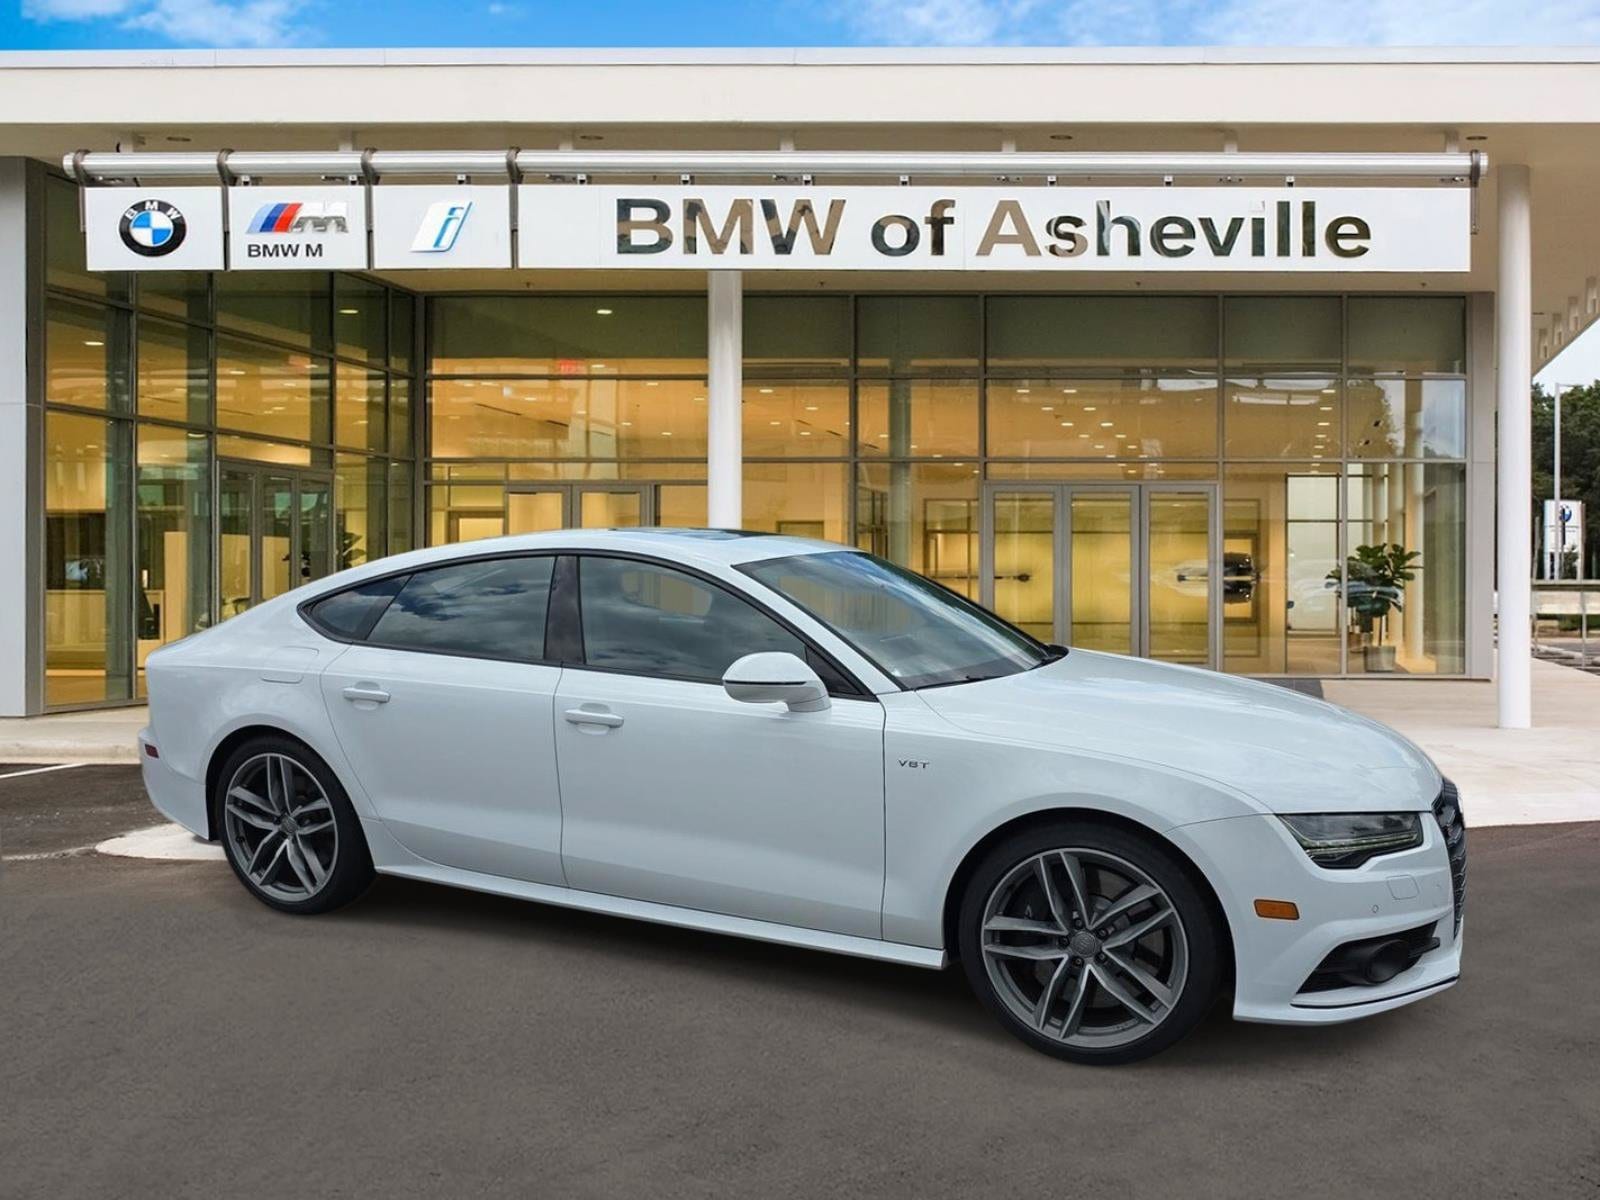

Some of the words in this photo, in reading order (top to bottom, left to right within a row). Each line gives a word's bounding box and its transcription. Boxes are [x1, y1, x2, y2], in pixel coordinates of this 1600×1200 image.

[616, 198, 846, 255] BMW
[871, 199, 956, 256] of
[977, 200, 1371, 257] Asheville
[247, 244, 299, 258] BMW
[305, 244, 323, 257] M
